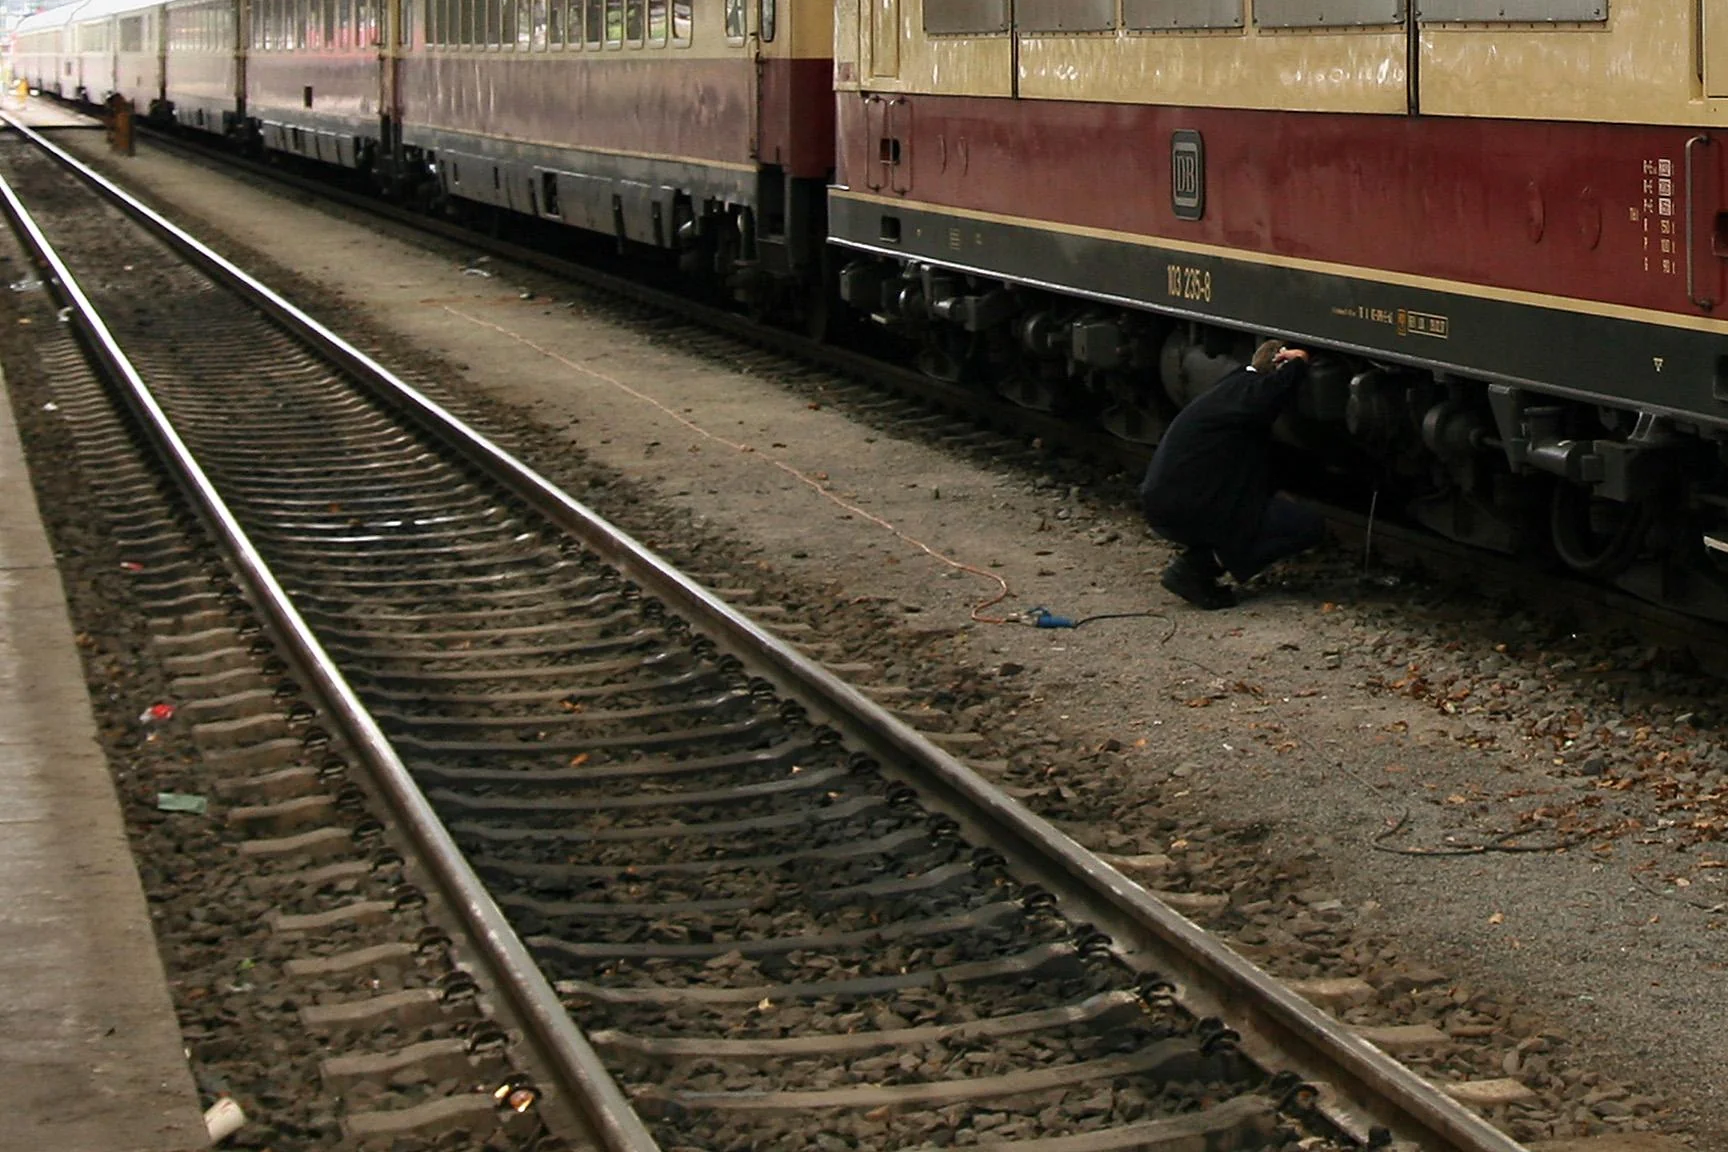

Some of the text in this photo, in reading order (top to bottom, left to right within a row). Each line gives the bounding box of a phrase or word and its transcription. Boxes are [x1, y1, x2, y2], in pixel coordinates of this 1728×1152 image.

[1176, 155, 1195, 193] DB
[1167, 264, 1211, 303] 103 235-8
